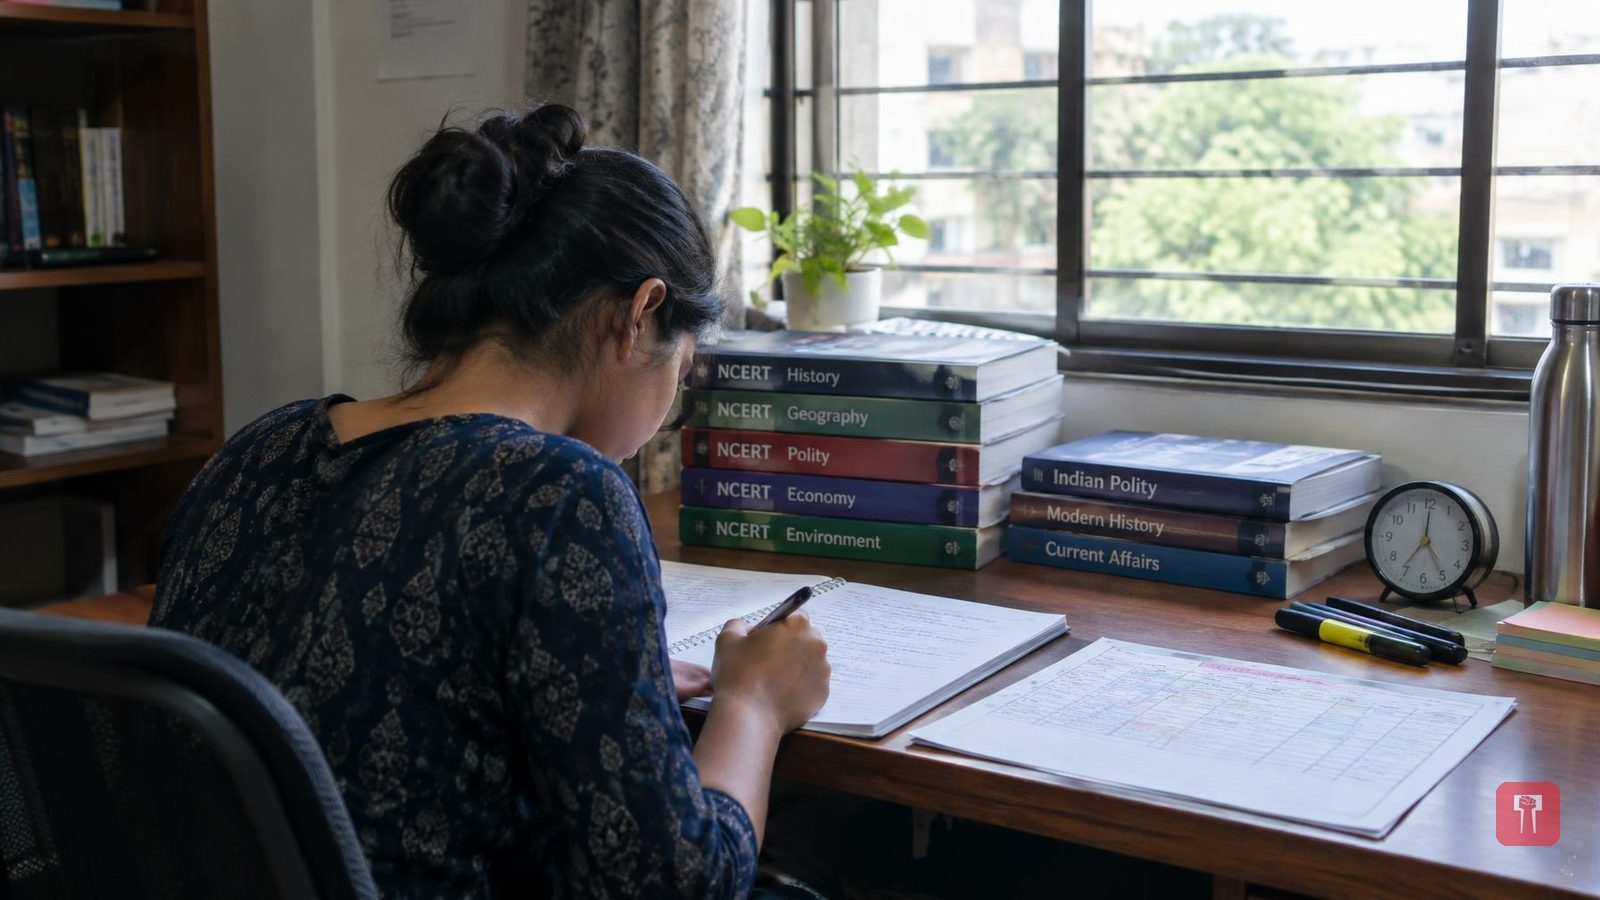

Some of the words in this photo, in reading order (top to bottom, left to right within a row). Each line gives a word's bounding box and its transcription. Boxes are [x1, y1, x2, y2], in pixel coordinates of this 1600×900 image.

[717, 364, 772, 382] NCERT
[787, 366, 841, 387] History
[717, 402, 773, 420] NCERT
[786, 405, 869, 427] Geography
[716, 443, 772, 460] NCERT
[787, 445, 831, 466] Polity
[1053, 468, 1104, 490] Indian
[1110, 475, 1158, 499] Polity
[716, 482, 772, 500] NCERT
[787, 486, 856, 508] Economy
[1407, 502, 1416, 514] 11
[1425, 498, 1436, 510] 12
[1447, 505, 1451, 516] 1
[1046, 505, 1104, 527] Modern
[1109, 512, 1165, 537] History
[1392, 515, 1404, 525] 10
[1458, 521, 1465, 532] 2
[715, 521, 770, 540] NCERT
[786, 526, 881, 550] Environment
[1385, 531, 1393, 542] 9
[1461, 540, 1470, 551] 3
[1045, 541, 1104, 564] Current
[1109, 550, 1160, 572] Affairs
[1389, 550, 1397, 561] 8
[1453, 559, 1461, 569] 4
[1402, 565, 1410, 577] 7
[1439, 570, 1446, 581] 5
[1419, 573, 1427, 584] 6
